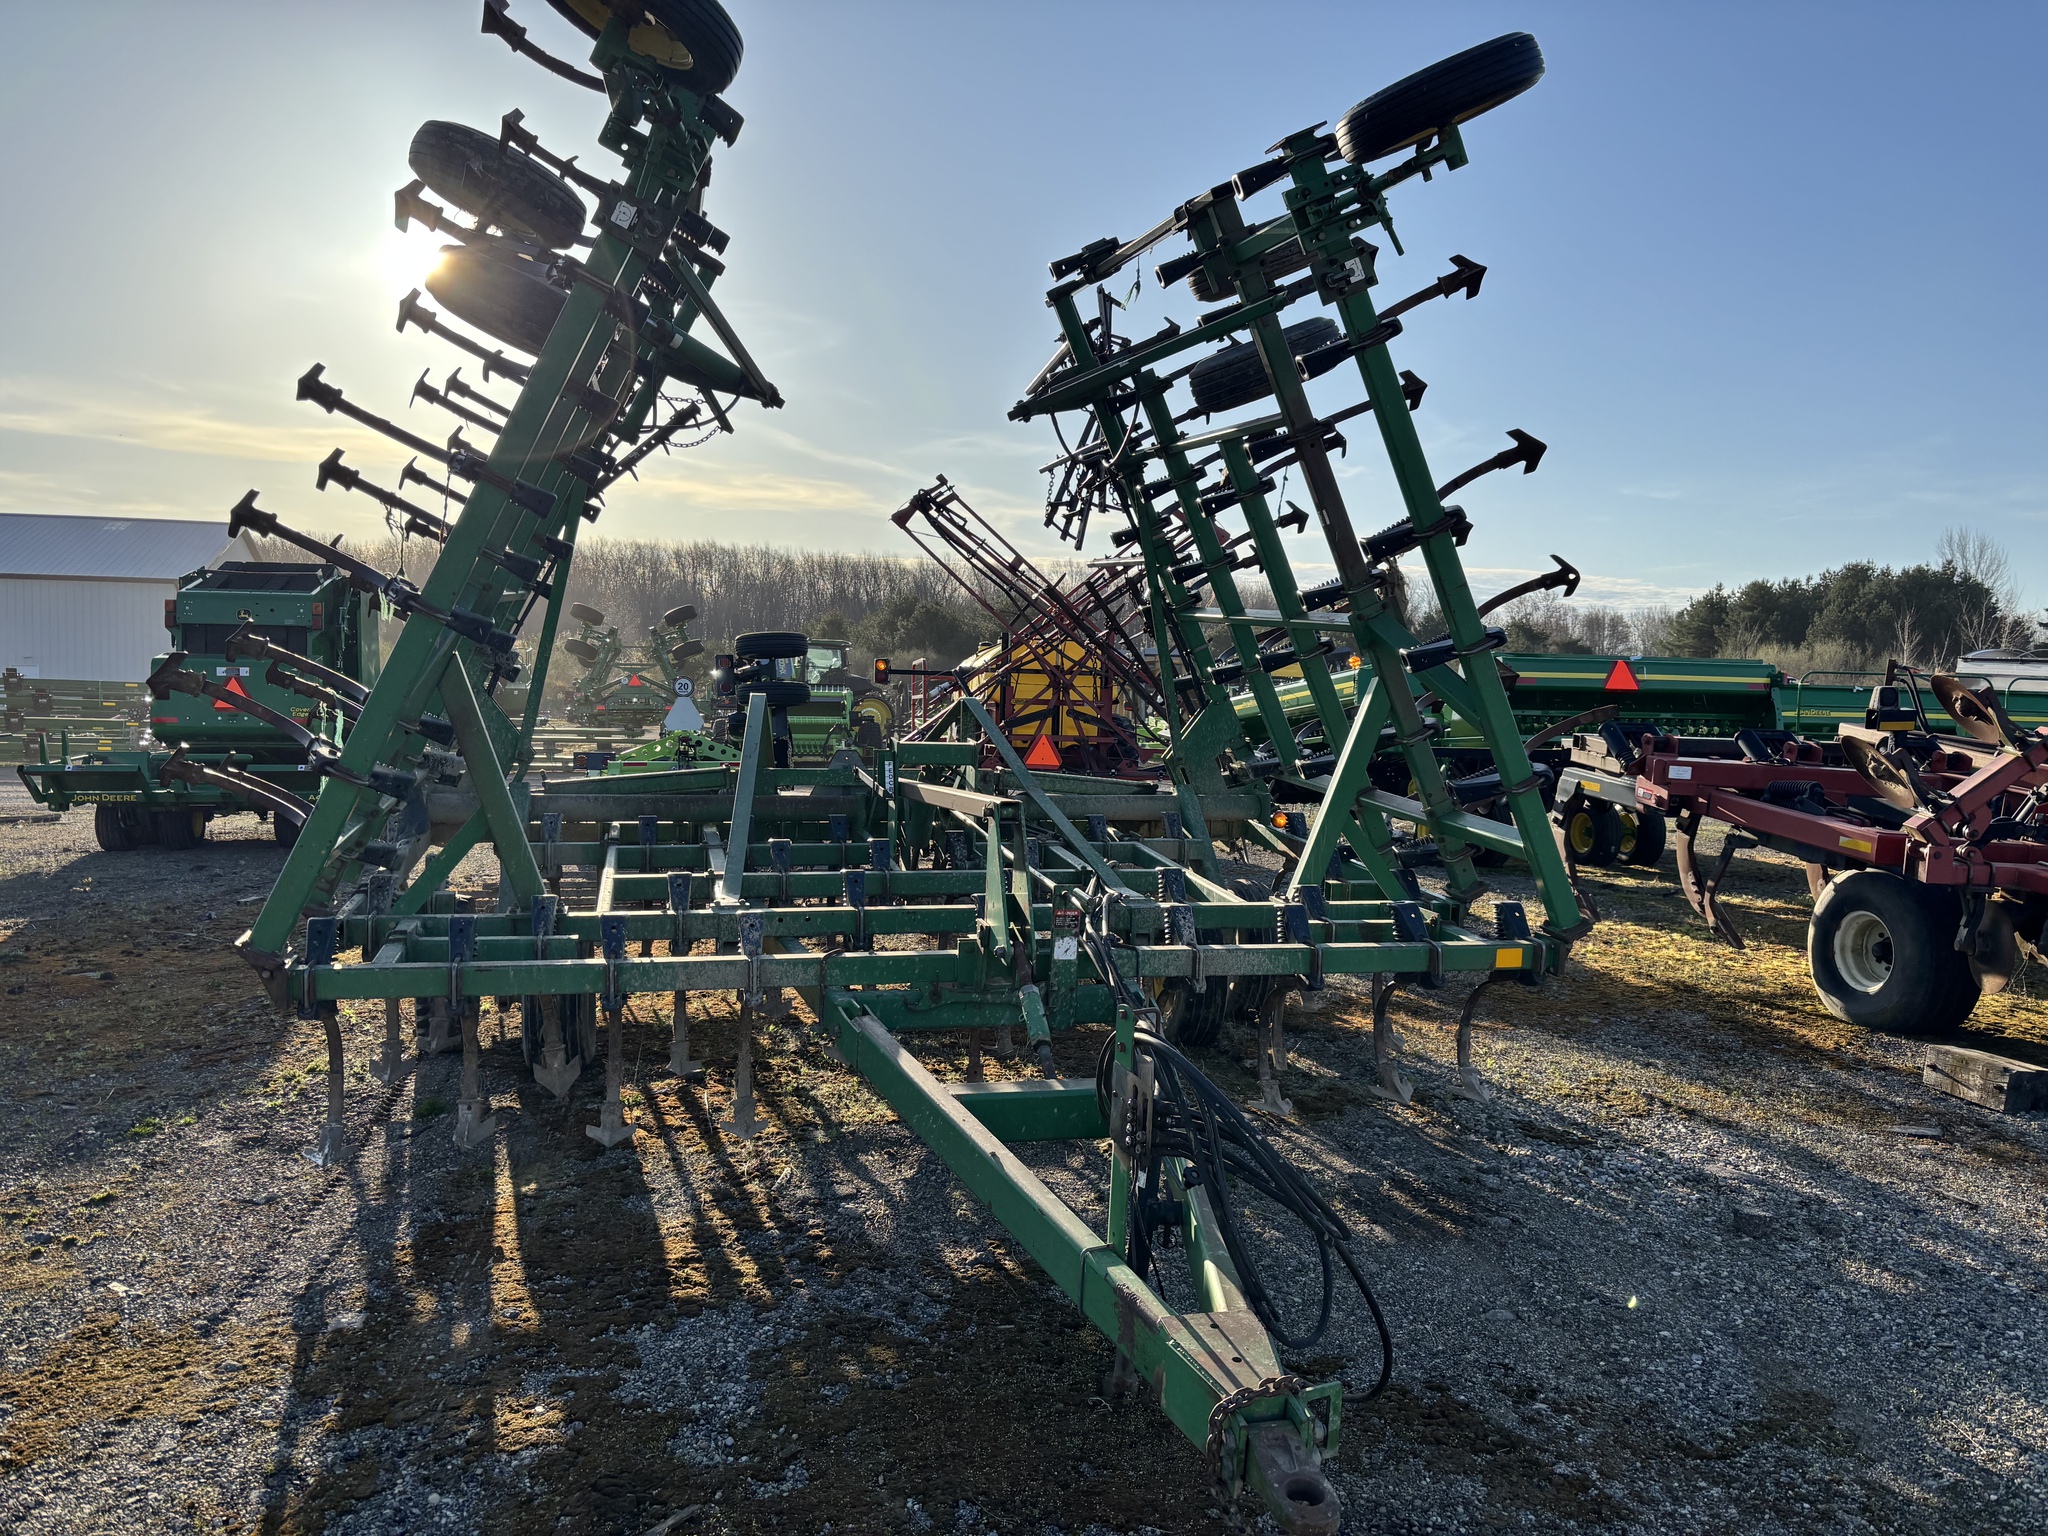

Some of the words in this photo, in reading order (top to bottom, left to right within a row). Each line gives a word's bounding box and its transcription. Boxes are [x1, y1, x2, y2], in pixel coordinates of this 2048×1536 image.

[677, 682, 689, 690] 20
[71, 794, 100, 802] JOHN
[101, 794, 137, 802] DEERE
